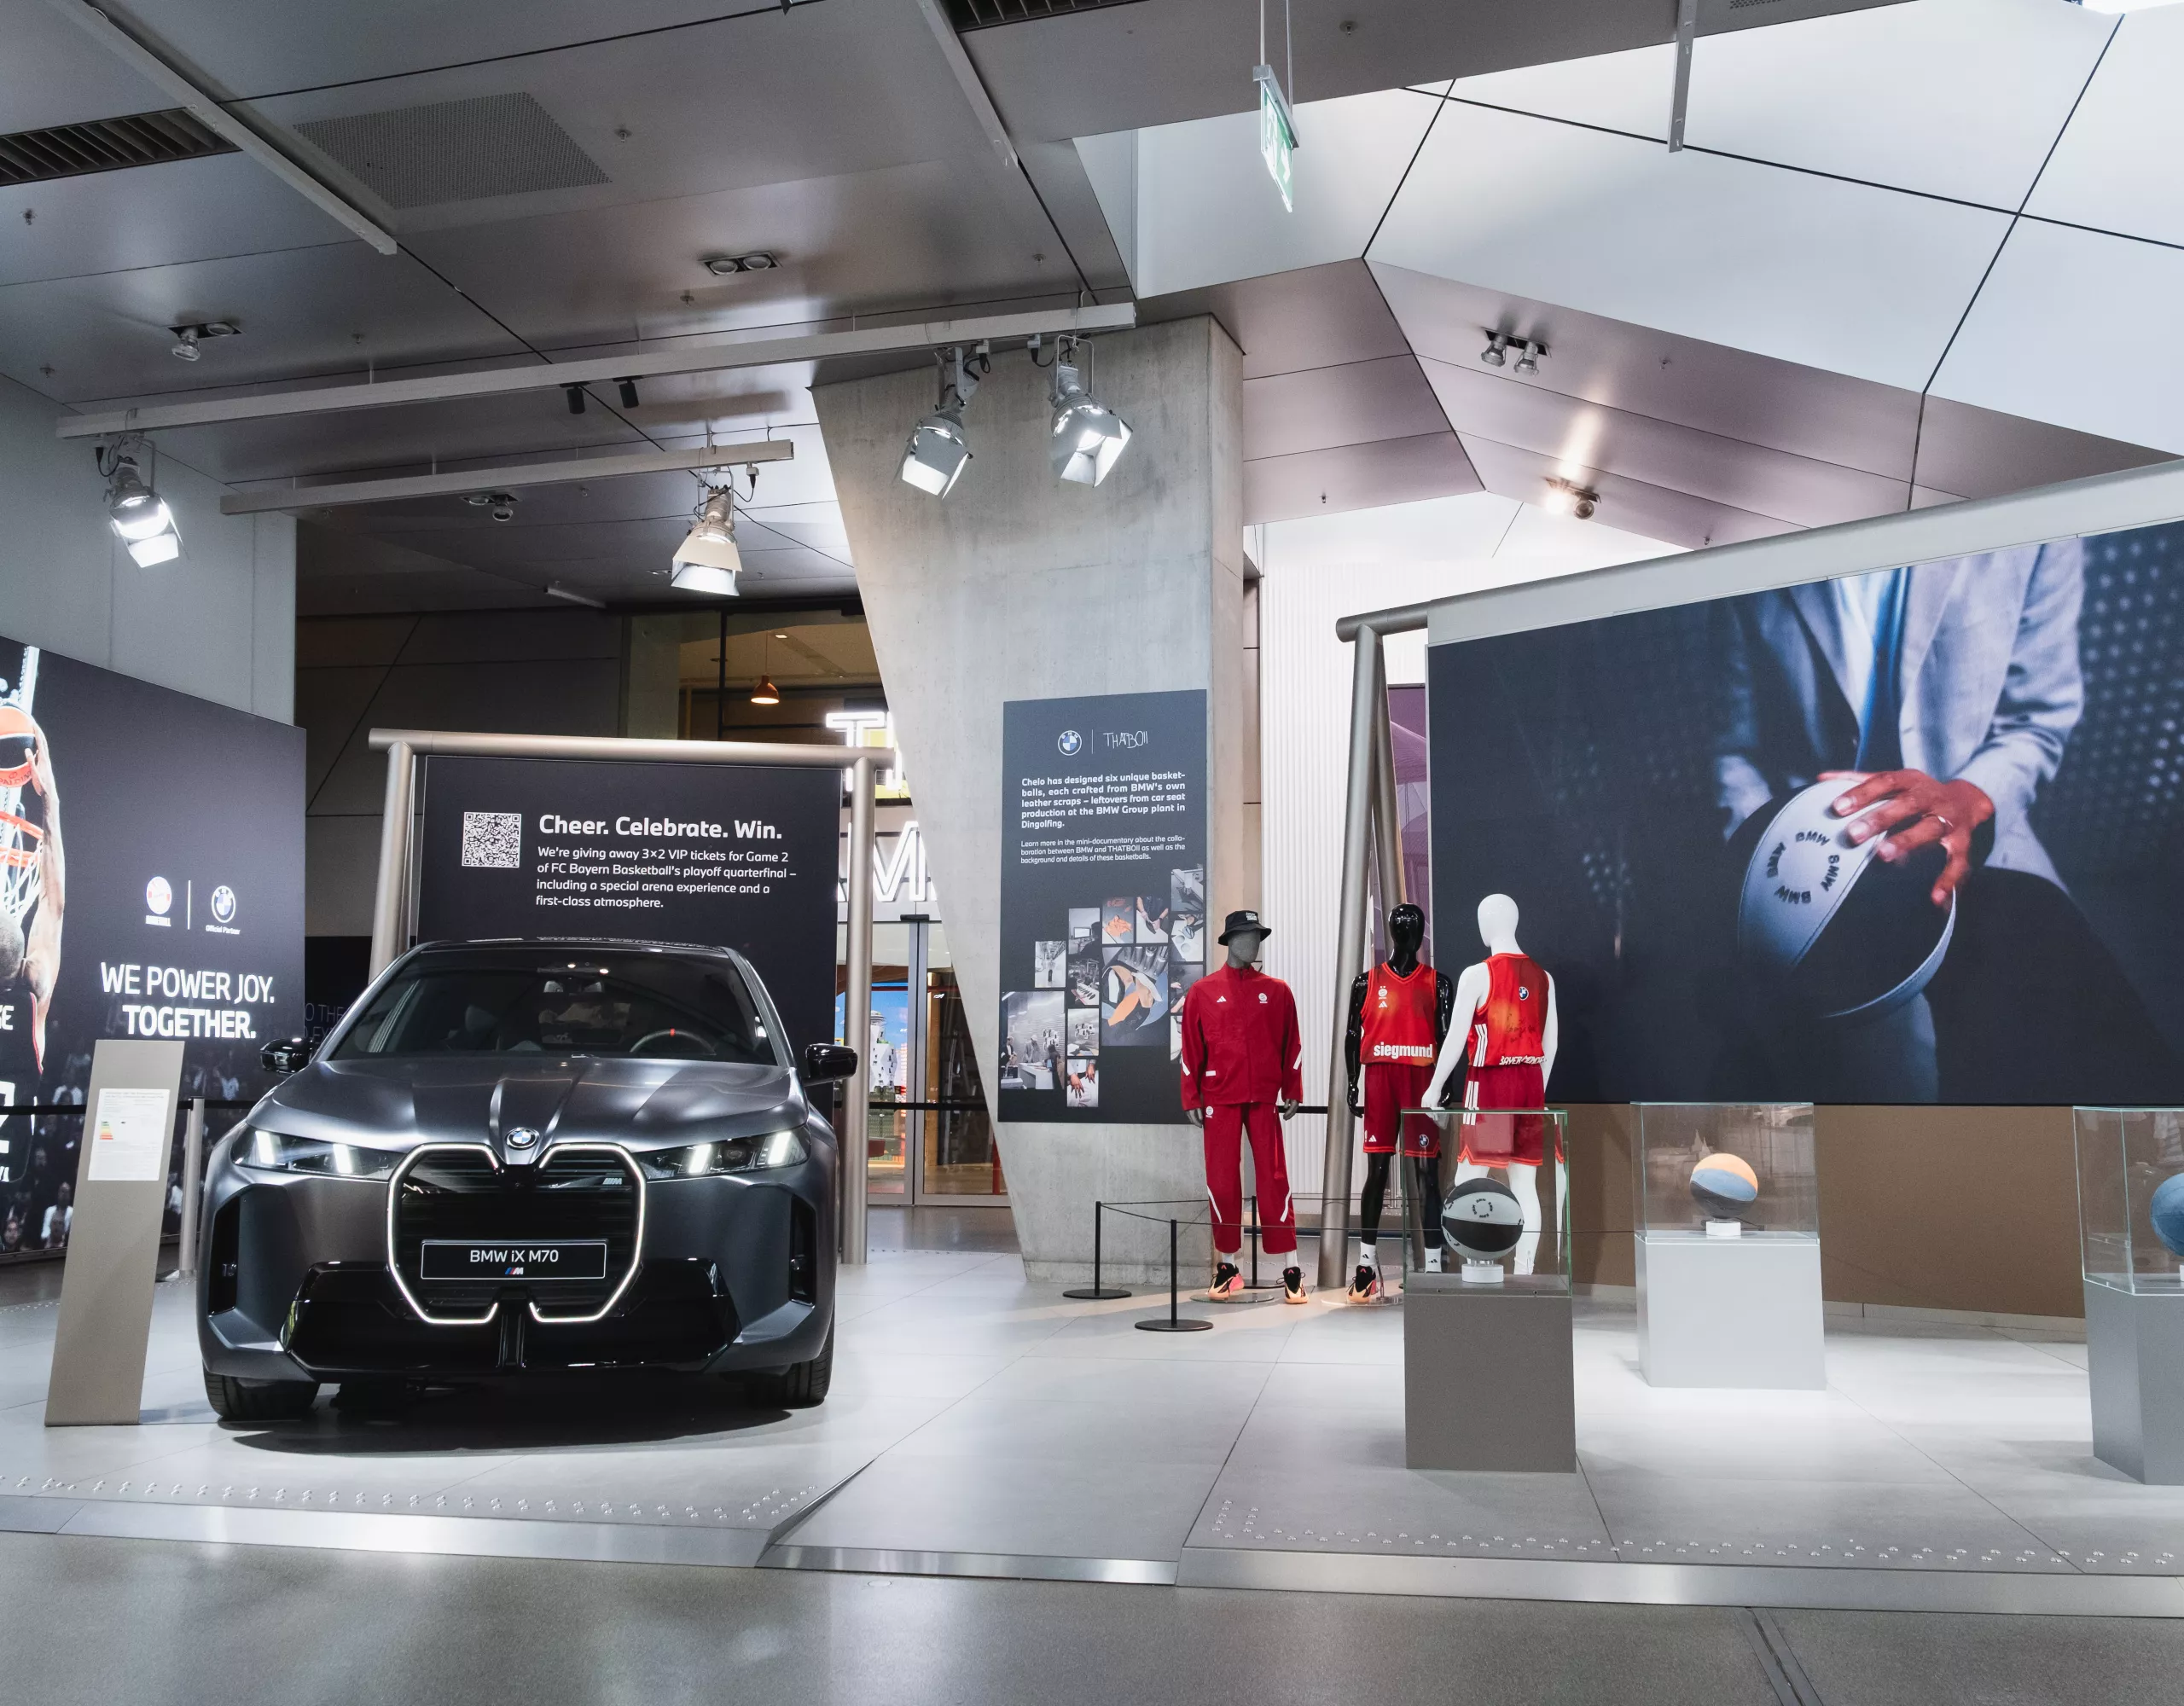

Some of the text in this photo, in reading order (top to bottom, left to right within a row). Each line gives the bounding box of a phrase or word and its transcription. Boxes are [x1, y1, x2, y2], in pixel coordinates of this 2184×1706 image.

[1021, 771, 1186, 786] Chelo has designed six unique basket-
[1021, 788, 1045, 798] balls,
[1048, 786, 1069, 796] each
[1072, 785, 1104, 794] crafted
[1107, 784, 1128, 792] from
[1130, 782, 1163, 792] BMW's
[1021, 799, 1052, 808] leather
[1053, 798, 1082, 807] scraps
[1090, 795, 1128, 804] leftovers
[1130, 794, 1149, 803] from
[1166, 792, 1186, 801] seat
[1021, 803, 1186, 819] production at the BMW Group plant in
[539, 814, 782, 839] Cheer. Celebrate. Win.
[1021, 820, 1065, 829] Dingolfing.
[1795, 830, 1831, 846] BMW
[537, 846, 571, 858] We're
[572, 848, 607, 860] giving
[608, 850, 639, 861] away
[668, 850, 688, 860] VIP
[690, 850, 726, 862] tickets
[729, 851, 744, 862] for
[746, 851, 778, 862] Game
[781, 852, 789, 862] 2
[1020, 856, 1055, 865] background
[537, 862, 549, 873] of
[551, 862, 567, 873] FC
[569, 863, 610, 876] Bayern
[613, 864, 681, 876] Basketball's
[683, 866, 722, 879] playoff
[723, 868, 787, 879] quarterfinal
[1821, 855, 1840, 892] BMW
[537, 879, 770, 895] including a special arena experience and a
[1774, 885, 1812, 905] BMW
[536, 895, 664, 909] first-class atmosphere.
[101, 961, 276, 1005] WE POWER JOY.
[122, 1004, 257, 1039] TOGETHER.
[1374, 1041, 1433, 1059] siegmund
[469, 1250, 559, 1262] BMW iX M70
